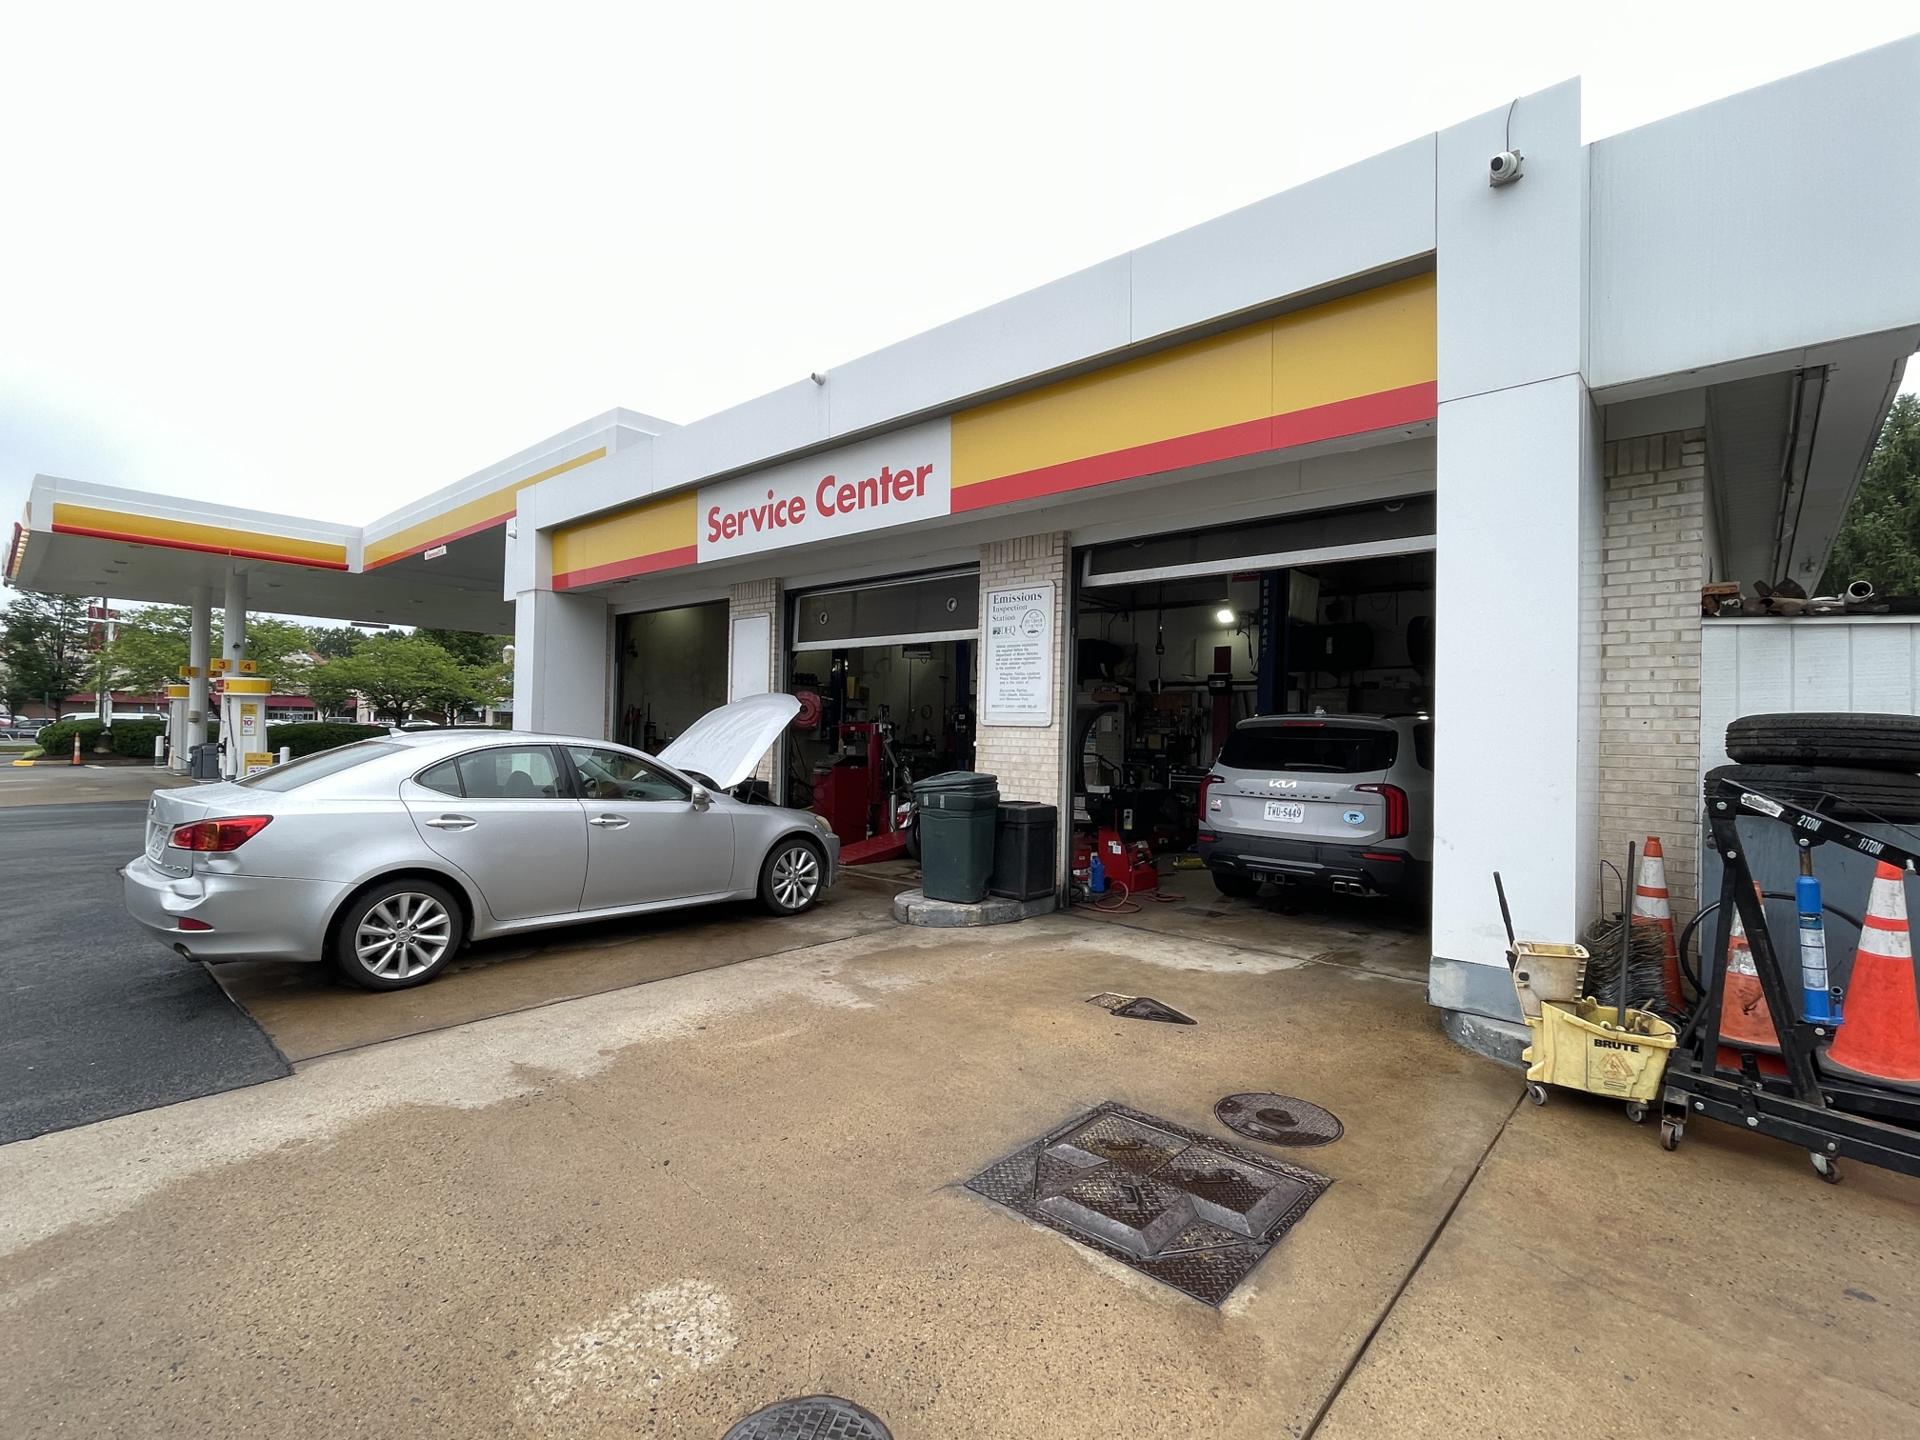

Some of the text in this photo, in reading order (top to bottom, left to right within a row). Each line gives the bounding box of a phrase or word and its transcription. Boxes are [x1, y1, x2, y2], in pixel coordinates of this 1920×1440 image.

[708, 463, 933, 543] Service Center
[993, 592, 1042, 605] Emissions
[992, 605, 1028, 614] Inspection
[219, 661, 226, 670] 3
[244, 663, 252, 671] 4
[1268, 780, 1297, 788] KIA
[1594, 1038, 1640, 1054] BRUTE
